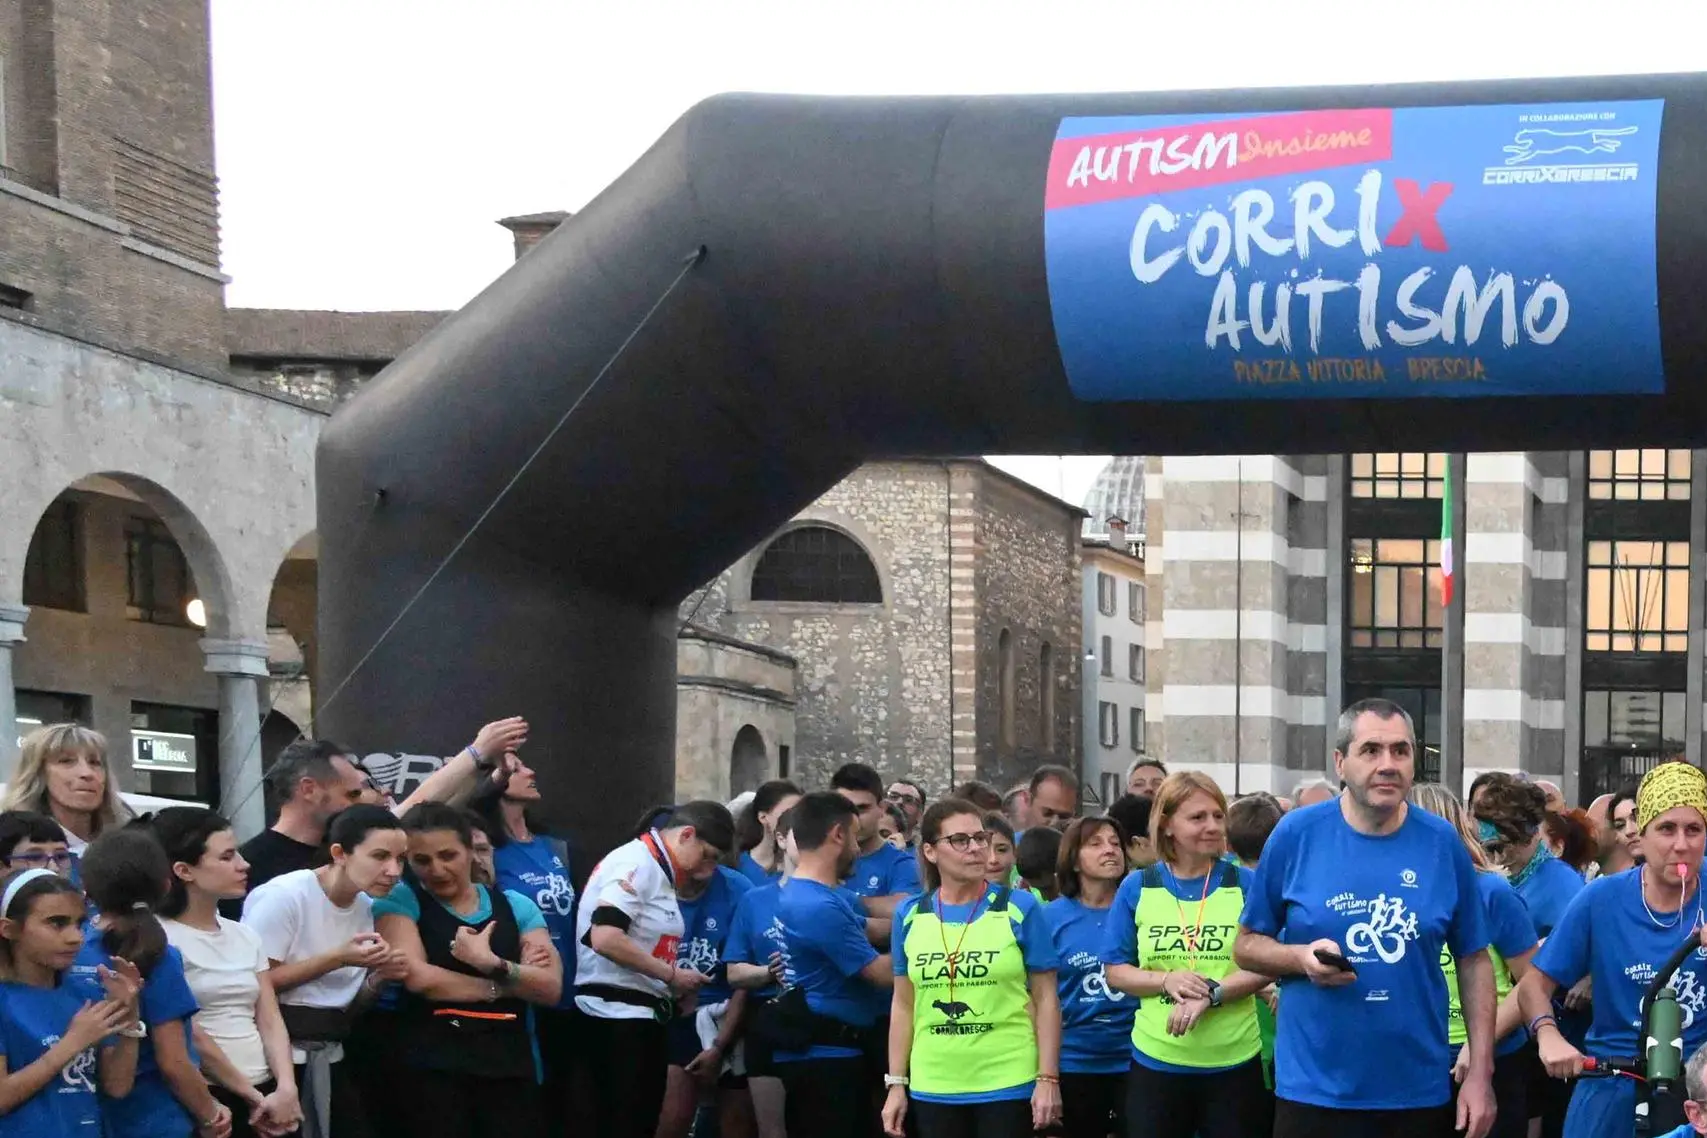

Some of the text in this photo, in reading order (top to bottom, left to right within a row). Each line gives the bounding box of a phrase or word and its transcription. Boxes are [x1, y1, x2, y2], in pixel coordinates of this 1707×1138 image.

[1205, 263, 1569, 355] AUTISMO
[1233, 358, 1486, 384] PIAZZA VITTORIA BRESCIA
[1149, 925, 1235, 939] SPORT
[1154, 938, 1223, 952] LAND
[915, 951, 1000, 967] SPORT
[922, 965, 989, 981] LAND
